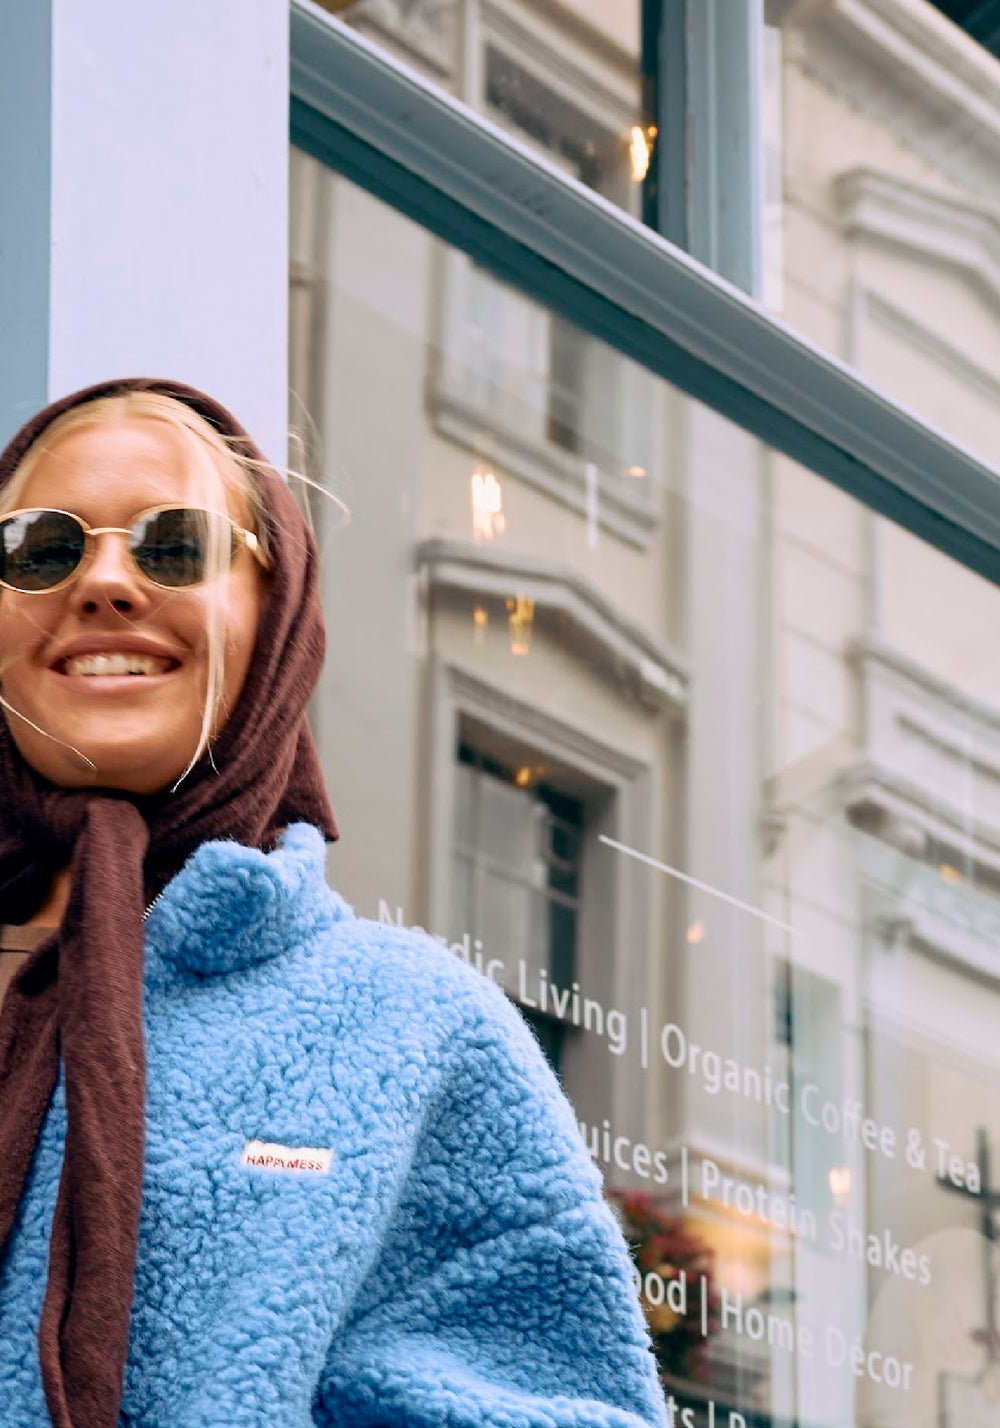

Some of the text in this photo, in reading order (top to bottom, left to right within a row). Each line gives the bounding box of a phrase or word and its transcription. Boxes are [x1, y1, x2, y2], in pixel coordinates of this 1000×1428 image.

[379, 899, 505, 986] Ndic
[519, 958, 627, 1056] Living
[661, 1023, 790, 1115] Organic
[801, 1083, 896, 1159] Coffee
[905, 1127, 926, 1170] &
[933, 1136, 981, 1194] Tea
[701, 1159, 817, 1242] Protein
[829, 1209, 931, 1285] Shakes
[721, 1287, 814, 1359] Home
